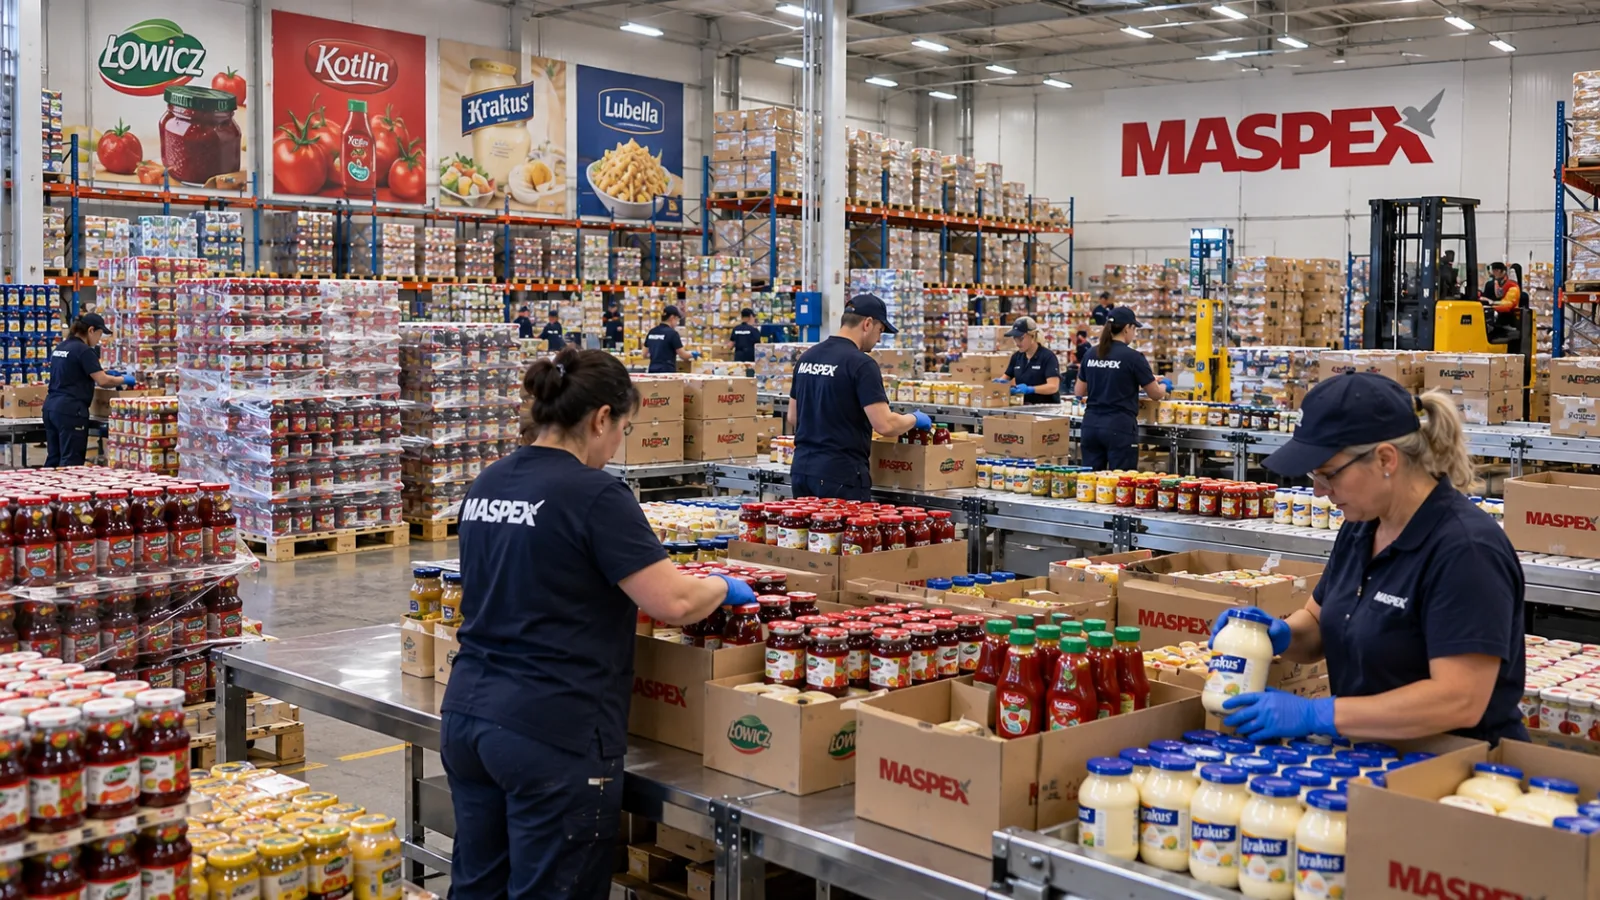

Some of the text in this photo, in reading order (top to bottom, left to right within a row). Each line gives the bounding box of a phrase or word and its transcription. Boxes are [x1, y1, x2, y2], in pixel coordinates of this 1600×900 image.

[315, 45, 389, 84] Kotlin
[468, 92, 529, 126] Krakus
[605, 96, 659, 125] Lubella
[1122, 106, 1434, 177] MASPEX
[798, 362, 836, 377] MASPEX
[1087, 359, 1120, 369] MASPEX
[462, 498, 537, 527] MASPEX
[1526, 511, 1597, 531] MASPEX
[1138, 609, 1211, 636] MASPEX
[1210, 656, 1240, 670] rakus
[632, 677, 687, 709] ASPEX
[880, 757, 969, 806] MASPEX
[1192, 824, 1231, 839] Krakus
[1243, 839, 1282, 853] Krakus
[1299, 853, 1341, 870] Krakus
